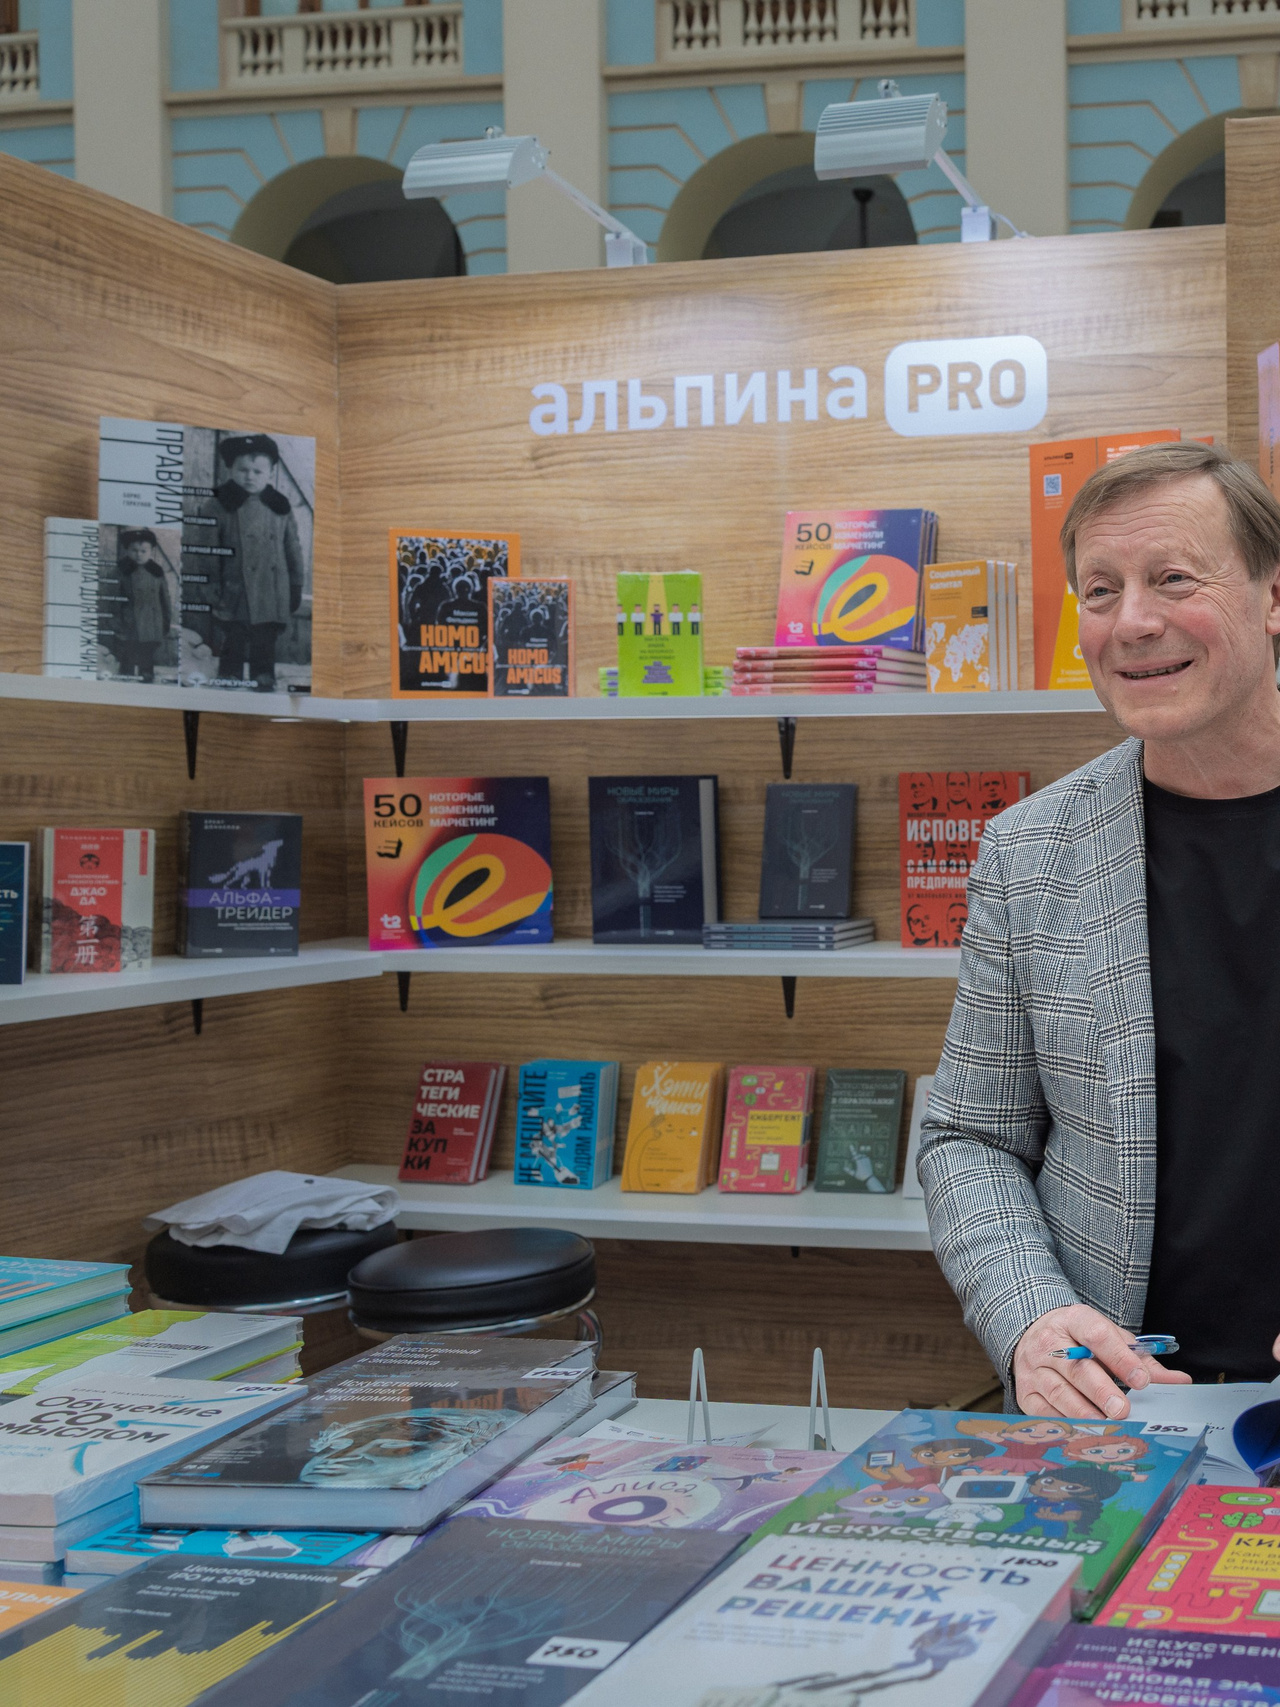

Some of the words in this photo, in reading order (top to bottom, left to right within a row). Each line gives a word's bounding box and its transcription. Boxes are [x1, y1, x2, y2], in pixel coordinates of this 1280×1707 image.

[529, 365, 868, 436] альпина
[906, 359, 1026, 413] PRO
[156, 428, 184, 525] ПРАВИЛА
[796, 522, 832, 542] 50
[420, 624, 479, 648] HOMO
[507, 648, 548, 664] HOMO
[506, 667, 562, 684] AMICUS
[373, 794, 422, 817] 50
[429, 792, 485, 802] КОТОРЫЕ
[429, 804, 495, 815] ИЗМЕНИЛИ
[373, 819, 424, 828] КЕЙСОВ
[429, 817, 499, 828] МАРКЕТИНГ
[907, 819, 990, 842] ИСПОВЕ
[70, 887, 107, 897] ДЖАО
[209, 891, 281, 905] АЛЬФА-
[216, 906, 293, 920] ТРЕЙДЕР
[423, 1068, 465, 1083] СТРА
[420, 1086, 460, 1101] ТЕГИ
[416, 1103, 481, 1119] ЧЕСКИЕ
[411, 1120, 436, 1135] ЗА
[407, 1137, 448, 1154] КУП
[404, 1155, 431, 1170] КИ
[35, 1396, 223, 1418] Обучение
[486, 1528, 597, 1544] НОВЫЕ
[600, 1533, 687, 1550] МИРЫ
[788, 1521, 1107, 1554] Искусственный
[183, 1564, 338, 1584] Ценообразование
[768, 1554, 1030, 1586] ЦЕННОСТЬ
[167, 1572, 200, 1582] IPO
[217, 1575, 256, 1586] SPO
[745, 1574, 952, 1602] ВАШИХ
[717, 1596, 997, 1633] РЕШЕНИЙ
[1116, 1653, 1193, 1669] РАЗУМ
[1106, 1671, 1121, 1681] И
[1128, 1673, 1212, 1689] НОВАЯ
[1218, 1679, 1263, 1693] ЭРА
